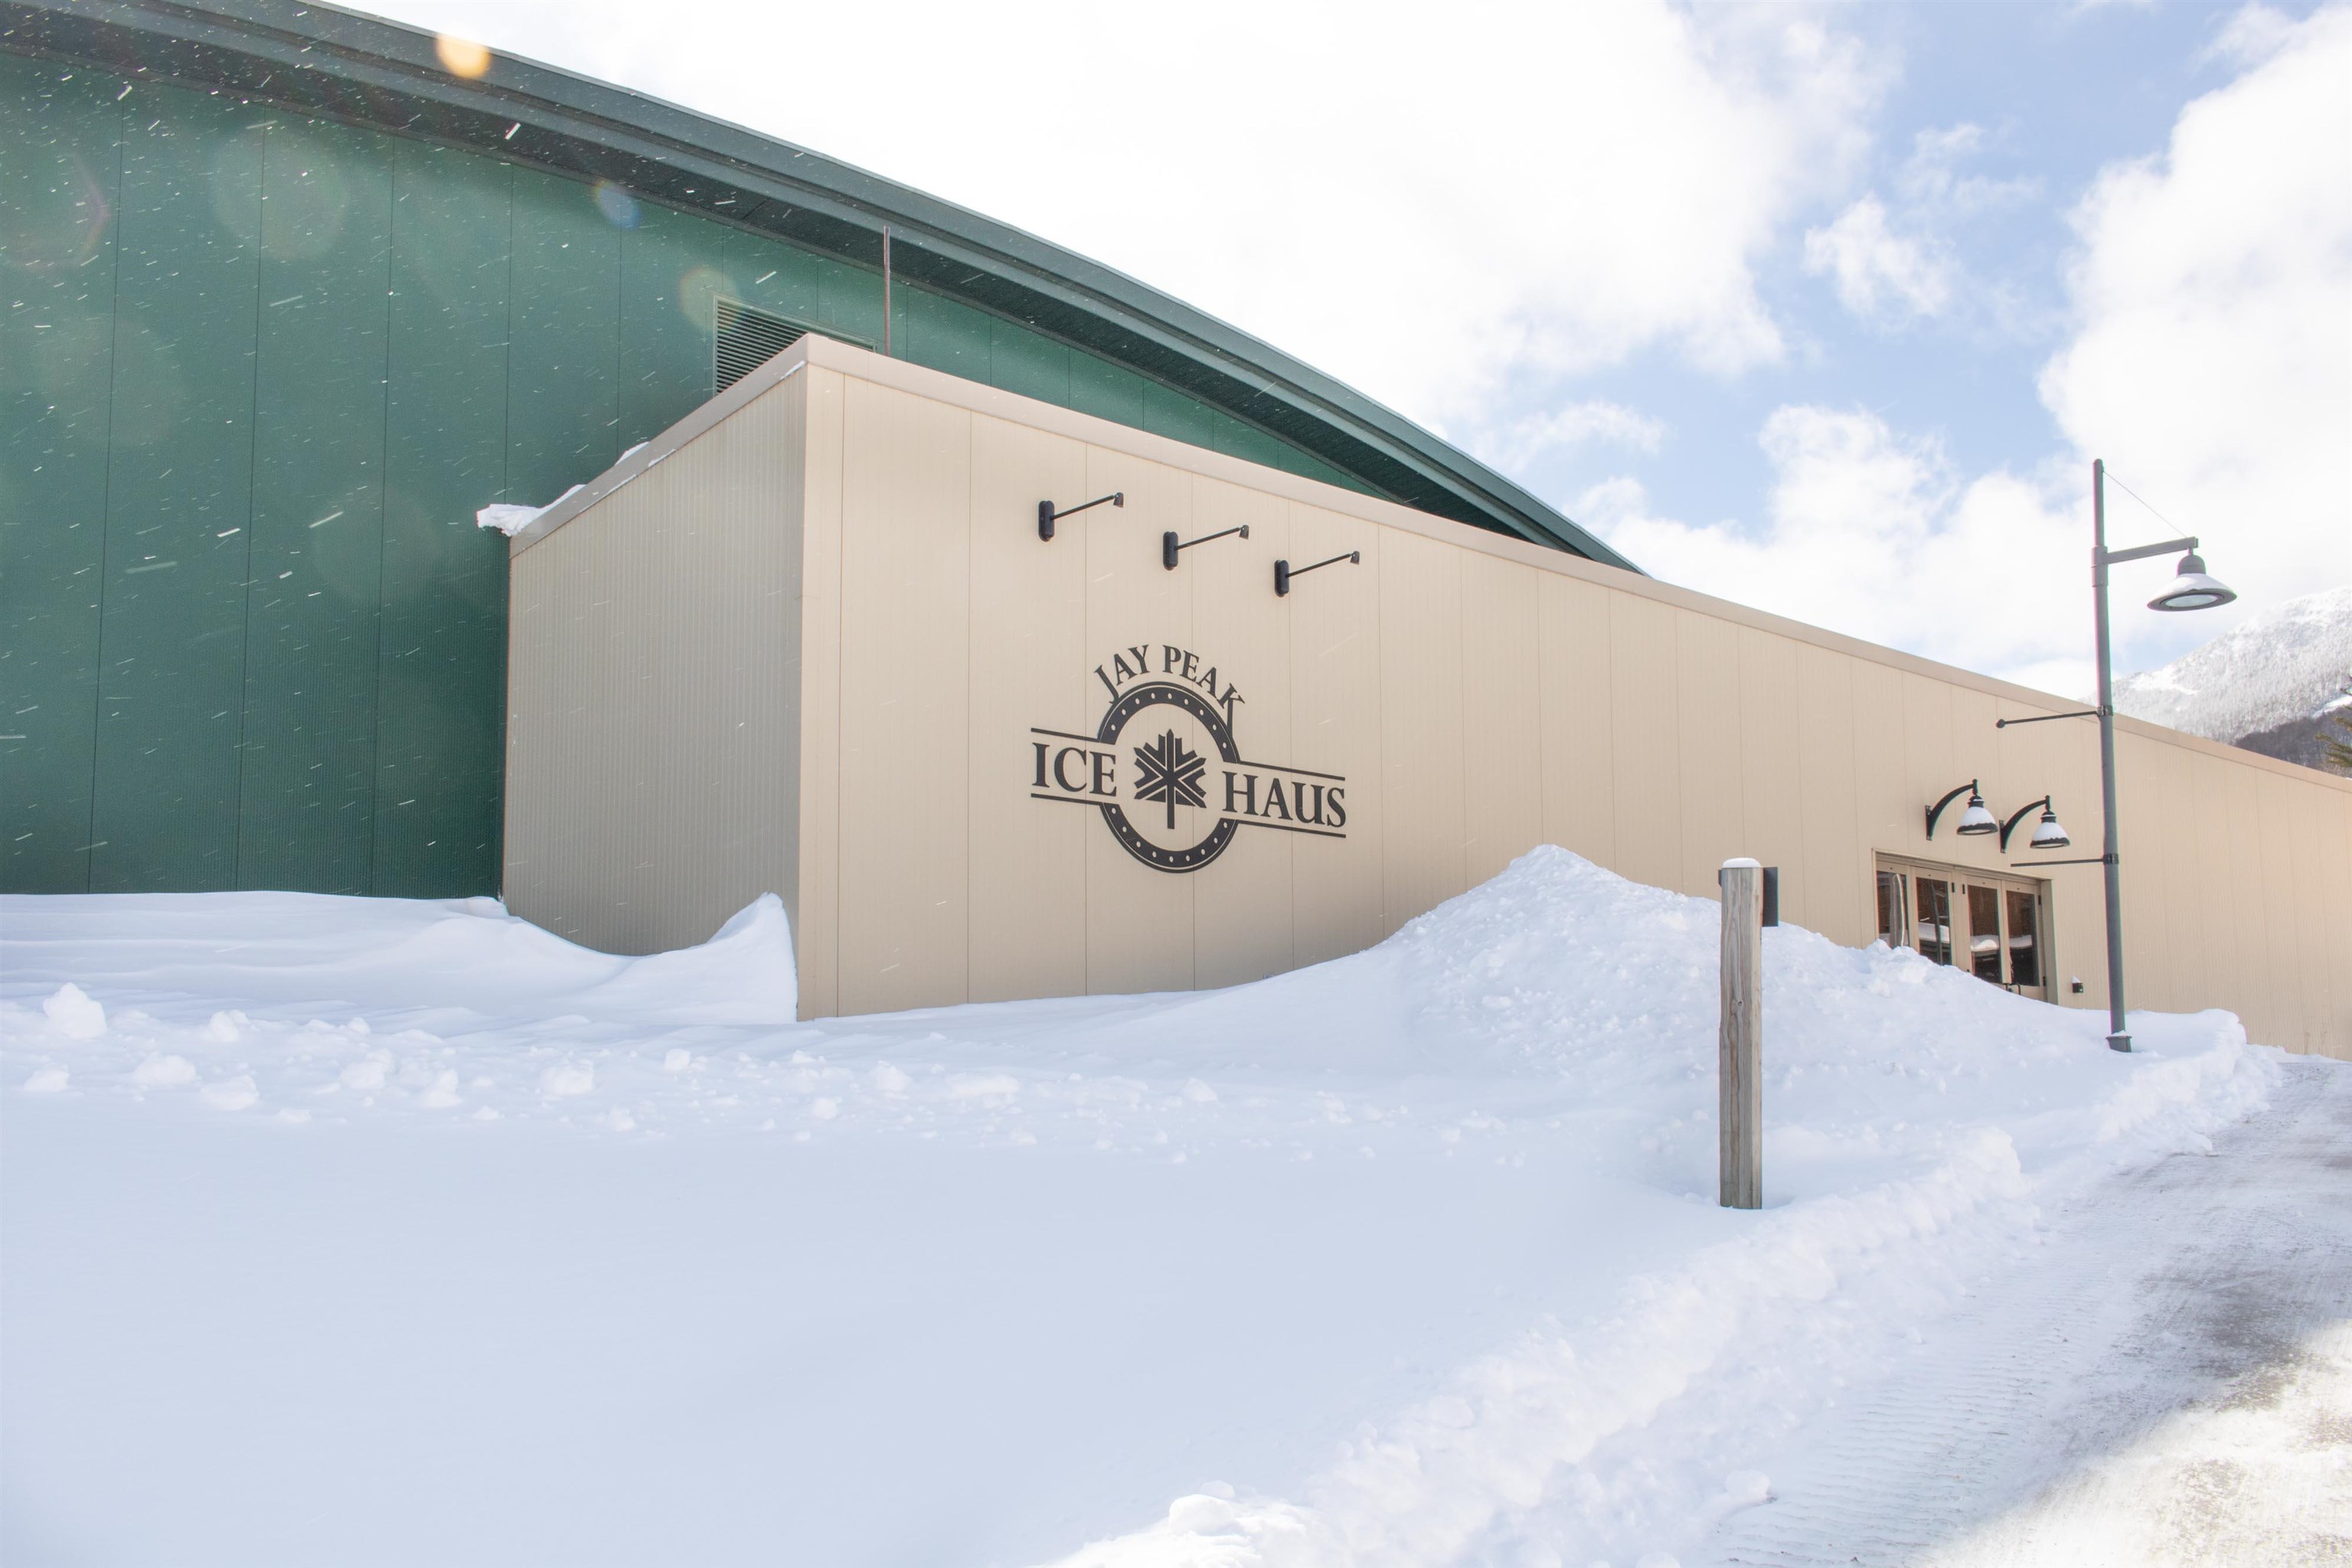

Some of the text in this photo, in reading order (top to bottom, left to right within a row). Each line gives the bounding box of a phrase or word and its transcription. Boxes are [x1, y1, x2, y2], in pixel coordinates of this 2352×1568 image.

[1093, 644, 1246, 737] JAY PEAK
[1031, 742, 1347, 828] ICE HAUS
